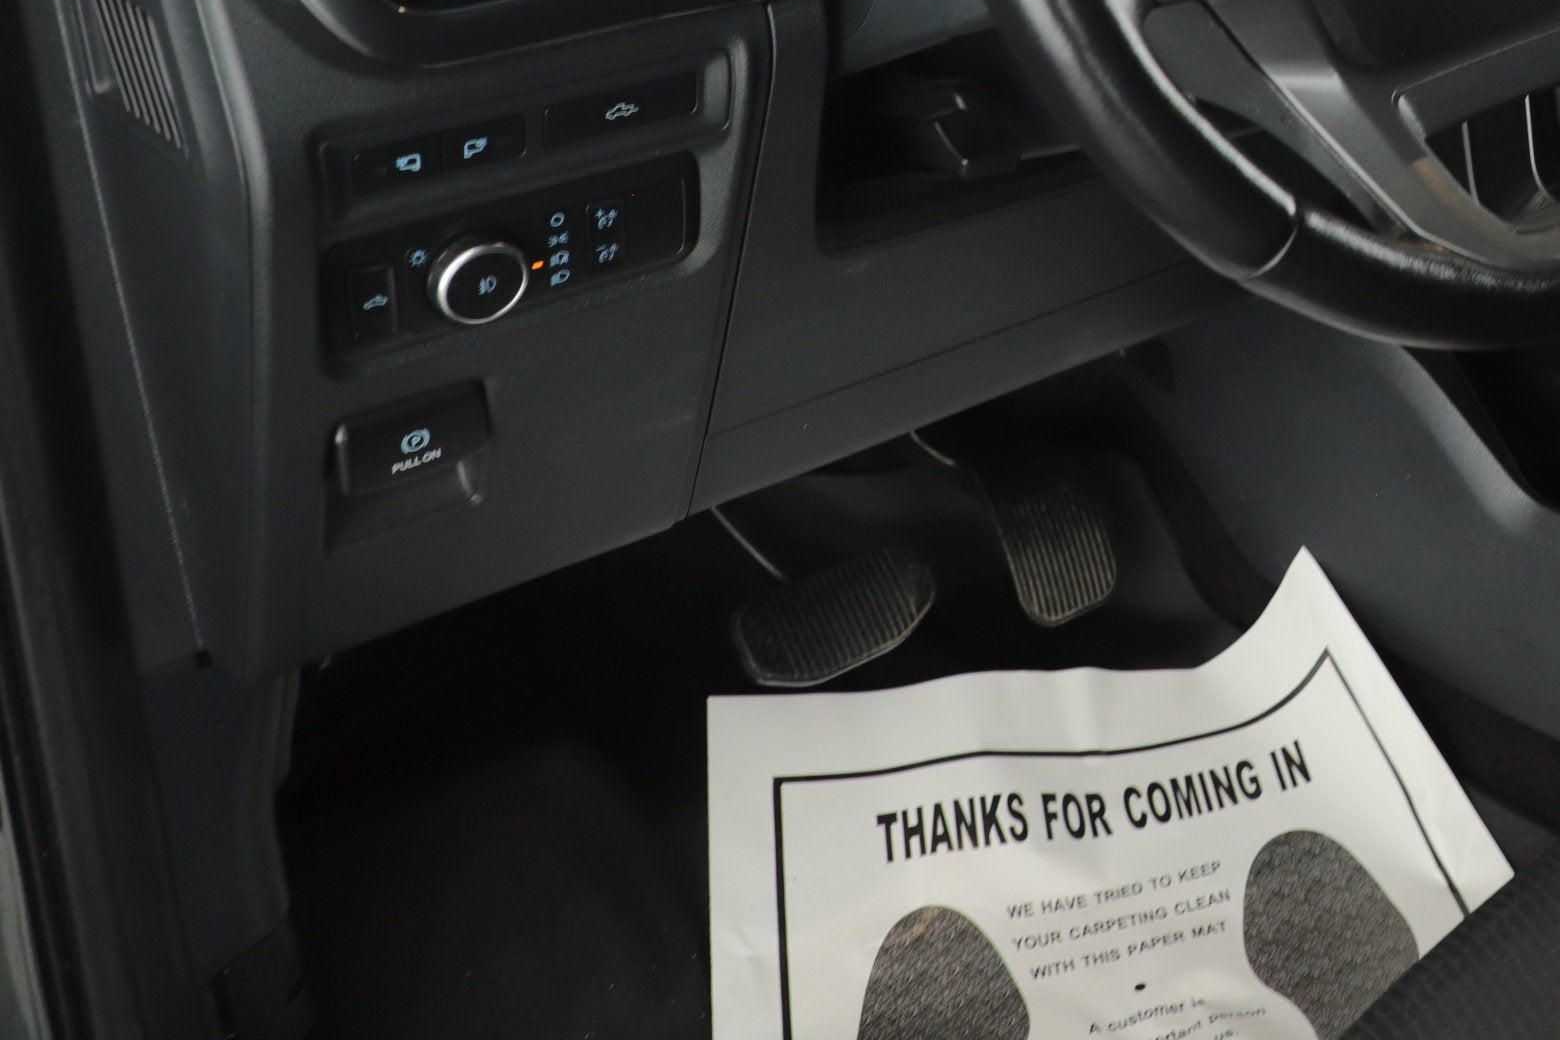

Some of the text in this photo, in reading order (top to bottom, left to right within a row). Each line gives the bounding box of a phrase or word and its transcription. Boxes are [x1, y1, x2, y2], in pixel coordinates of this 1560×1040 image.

[391, 447, 442, 475] PULL ON
[876, 738, 1312, 863] THANKS FOR COMING IN
[1006, 859, 1222, 919] WE HAVE TRIED TO KEEP
[1012, 887, 1231, 951] YOUR CARPETING CLEAN
[1030, 919, 1229, 980] WITH THIS PAPER MAT
[1088, 1022, 1101, 1035] A
[1107, 1000, 1185, 1033] customer
